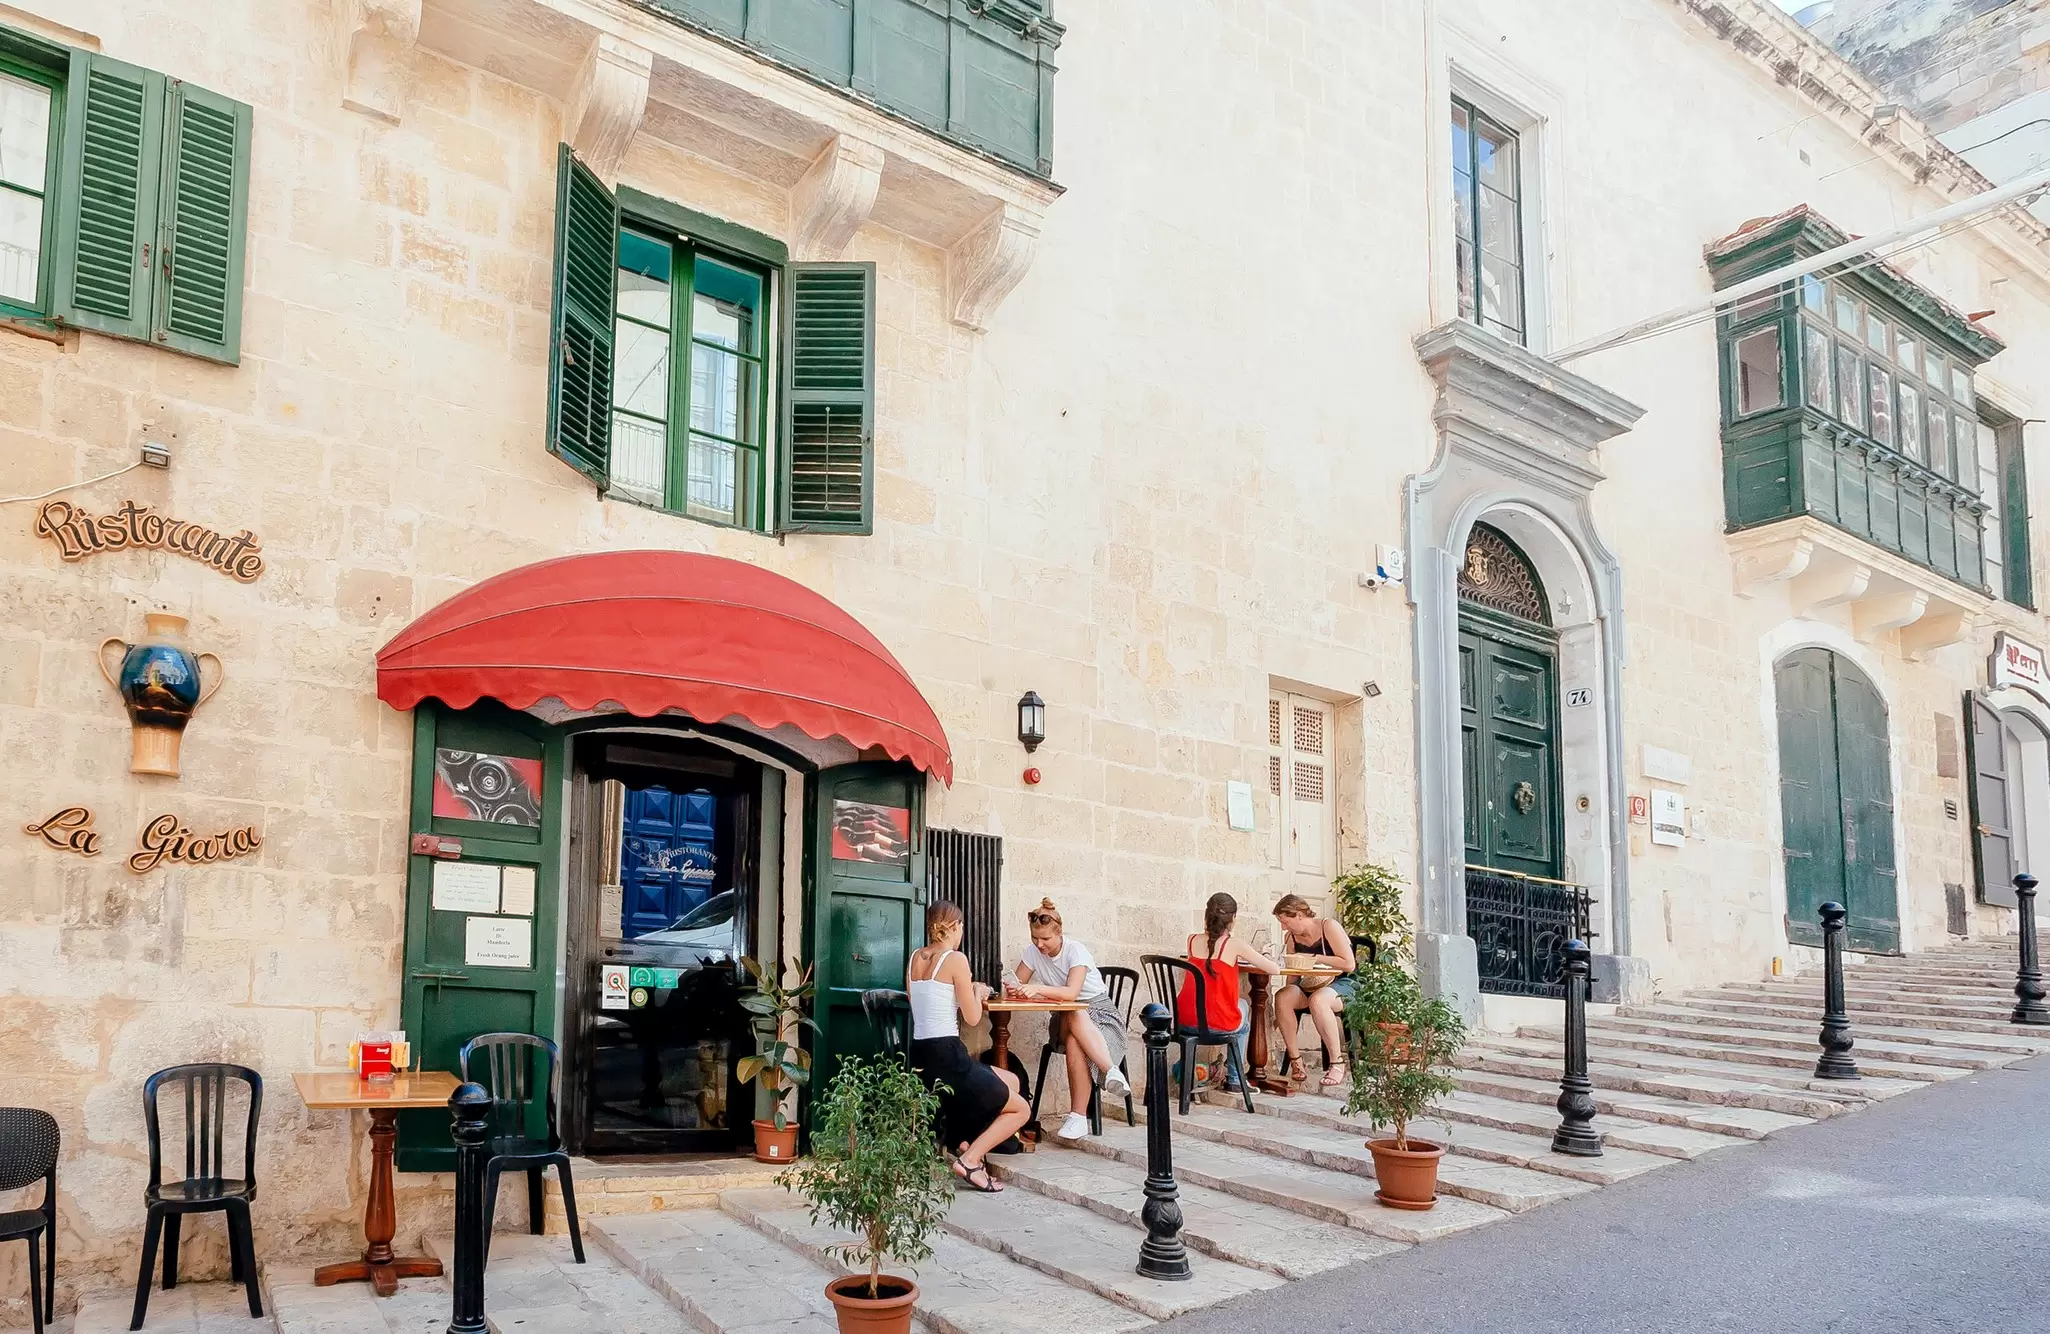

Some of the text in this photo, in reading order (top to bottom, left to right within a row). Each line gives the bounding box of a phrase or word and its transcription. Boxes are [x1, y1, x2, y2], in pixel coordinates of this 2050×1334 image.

[37, 499, 263, 580] Ristorante
[1571, 691, 1586, 704] 74
[26, 807, 261, 871] La Giara
[670, 846, 718, 863] RISTORANTE
[661, 856, 679, 872] La
